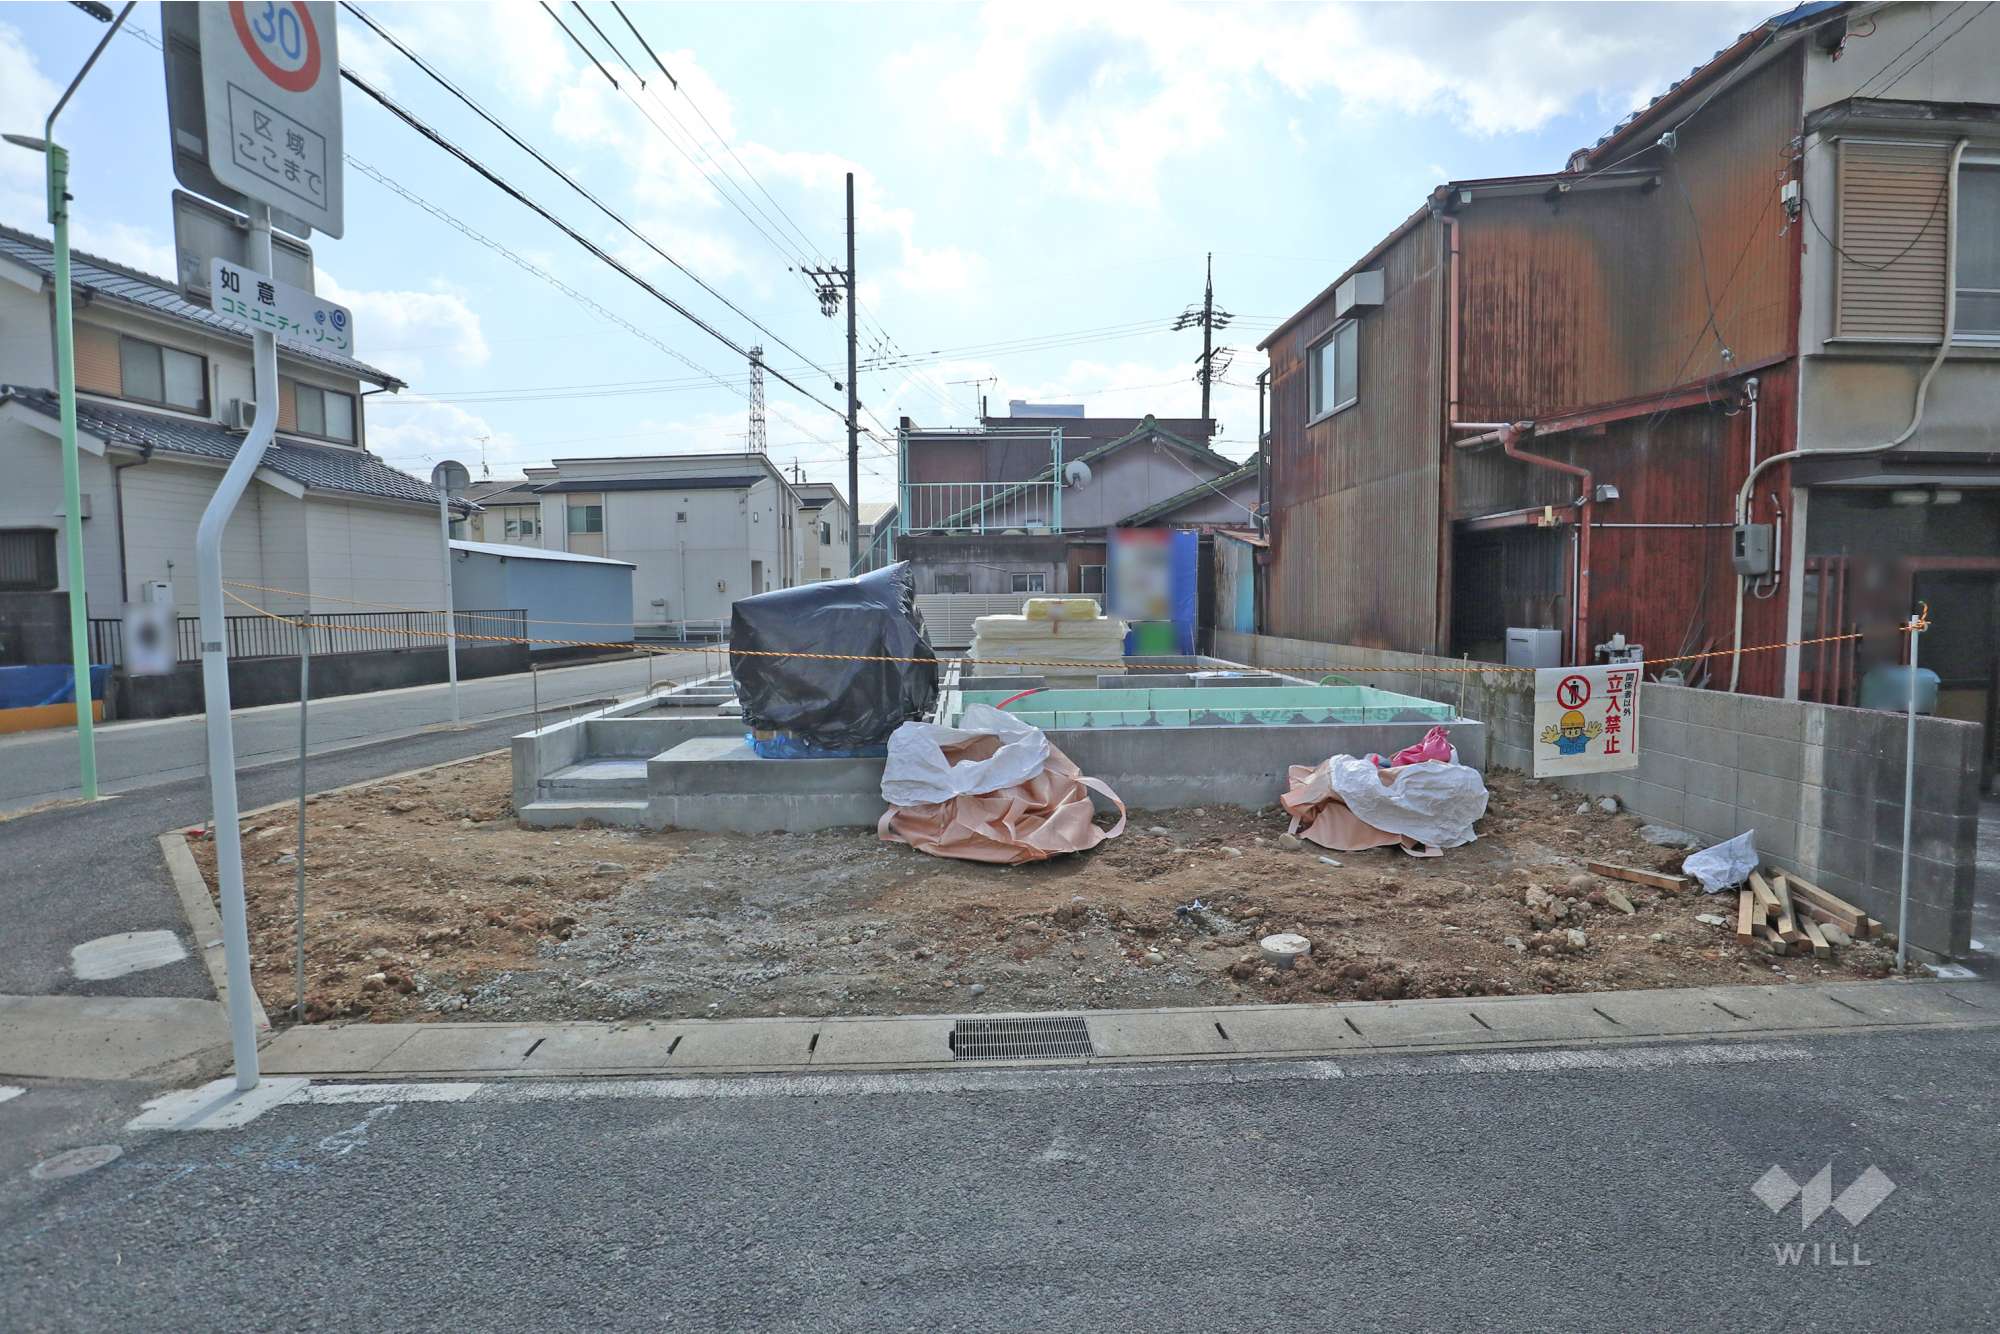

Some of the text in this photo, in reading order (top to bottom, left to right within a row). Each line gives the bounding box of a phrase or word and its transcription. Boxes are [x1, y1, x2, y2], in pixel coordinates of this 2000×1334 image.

[251, 1, 300, 60] 30
[239, 132, 322, 196] ここまで
[220, 266, 276, 307] 如意
[1603, 674, 1623, 754] 立入禁止
